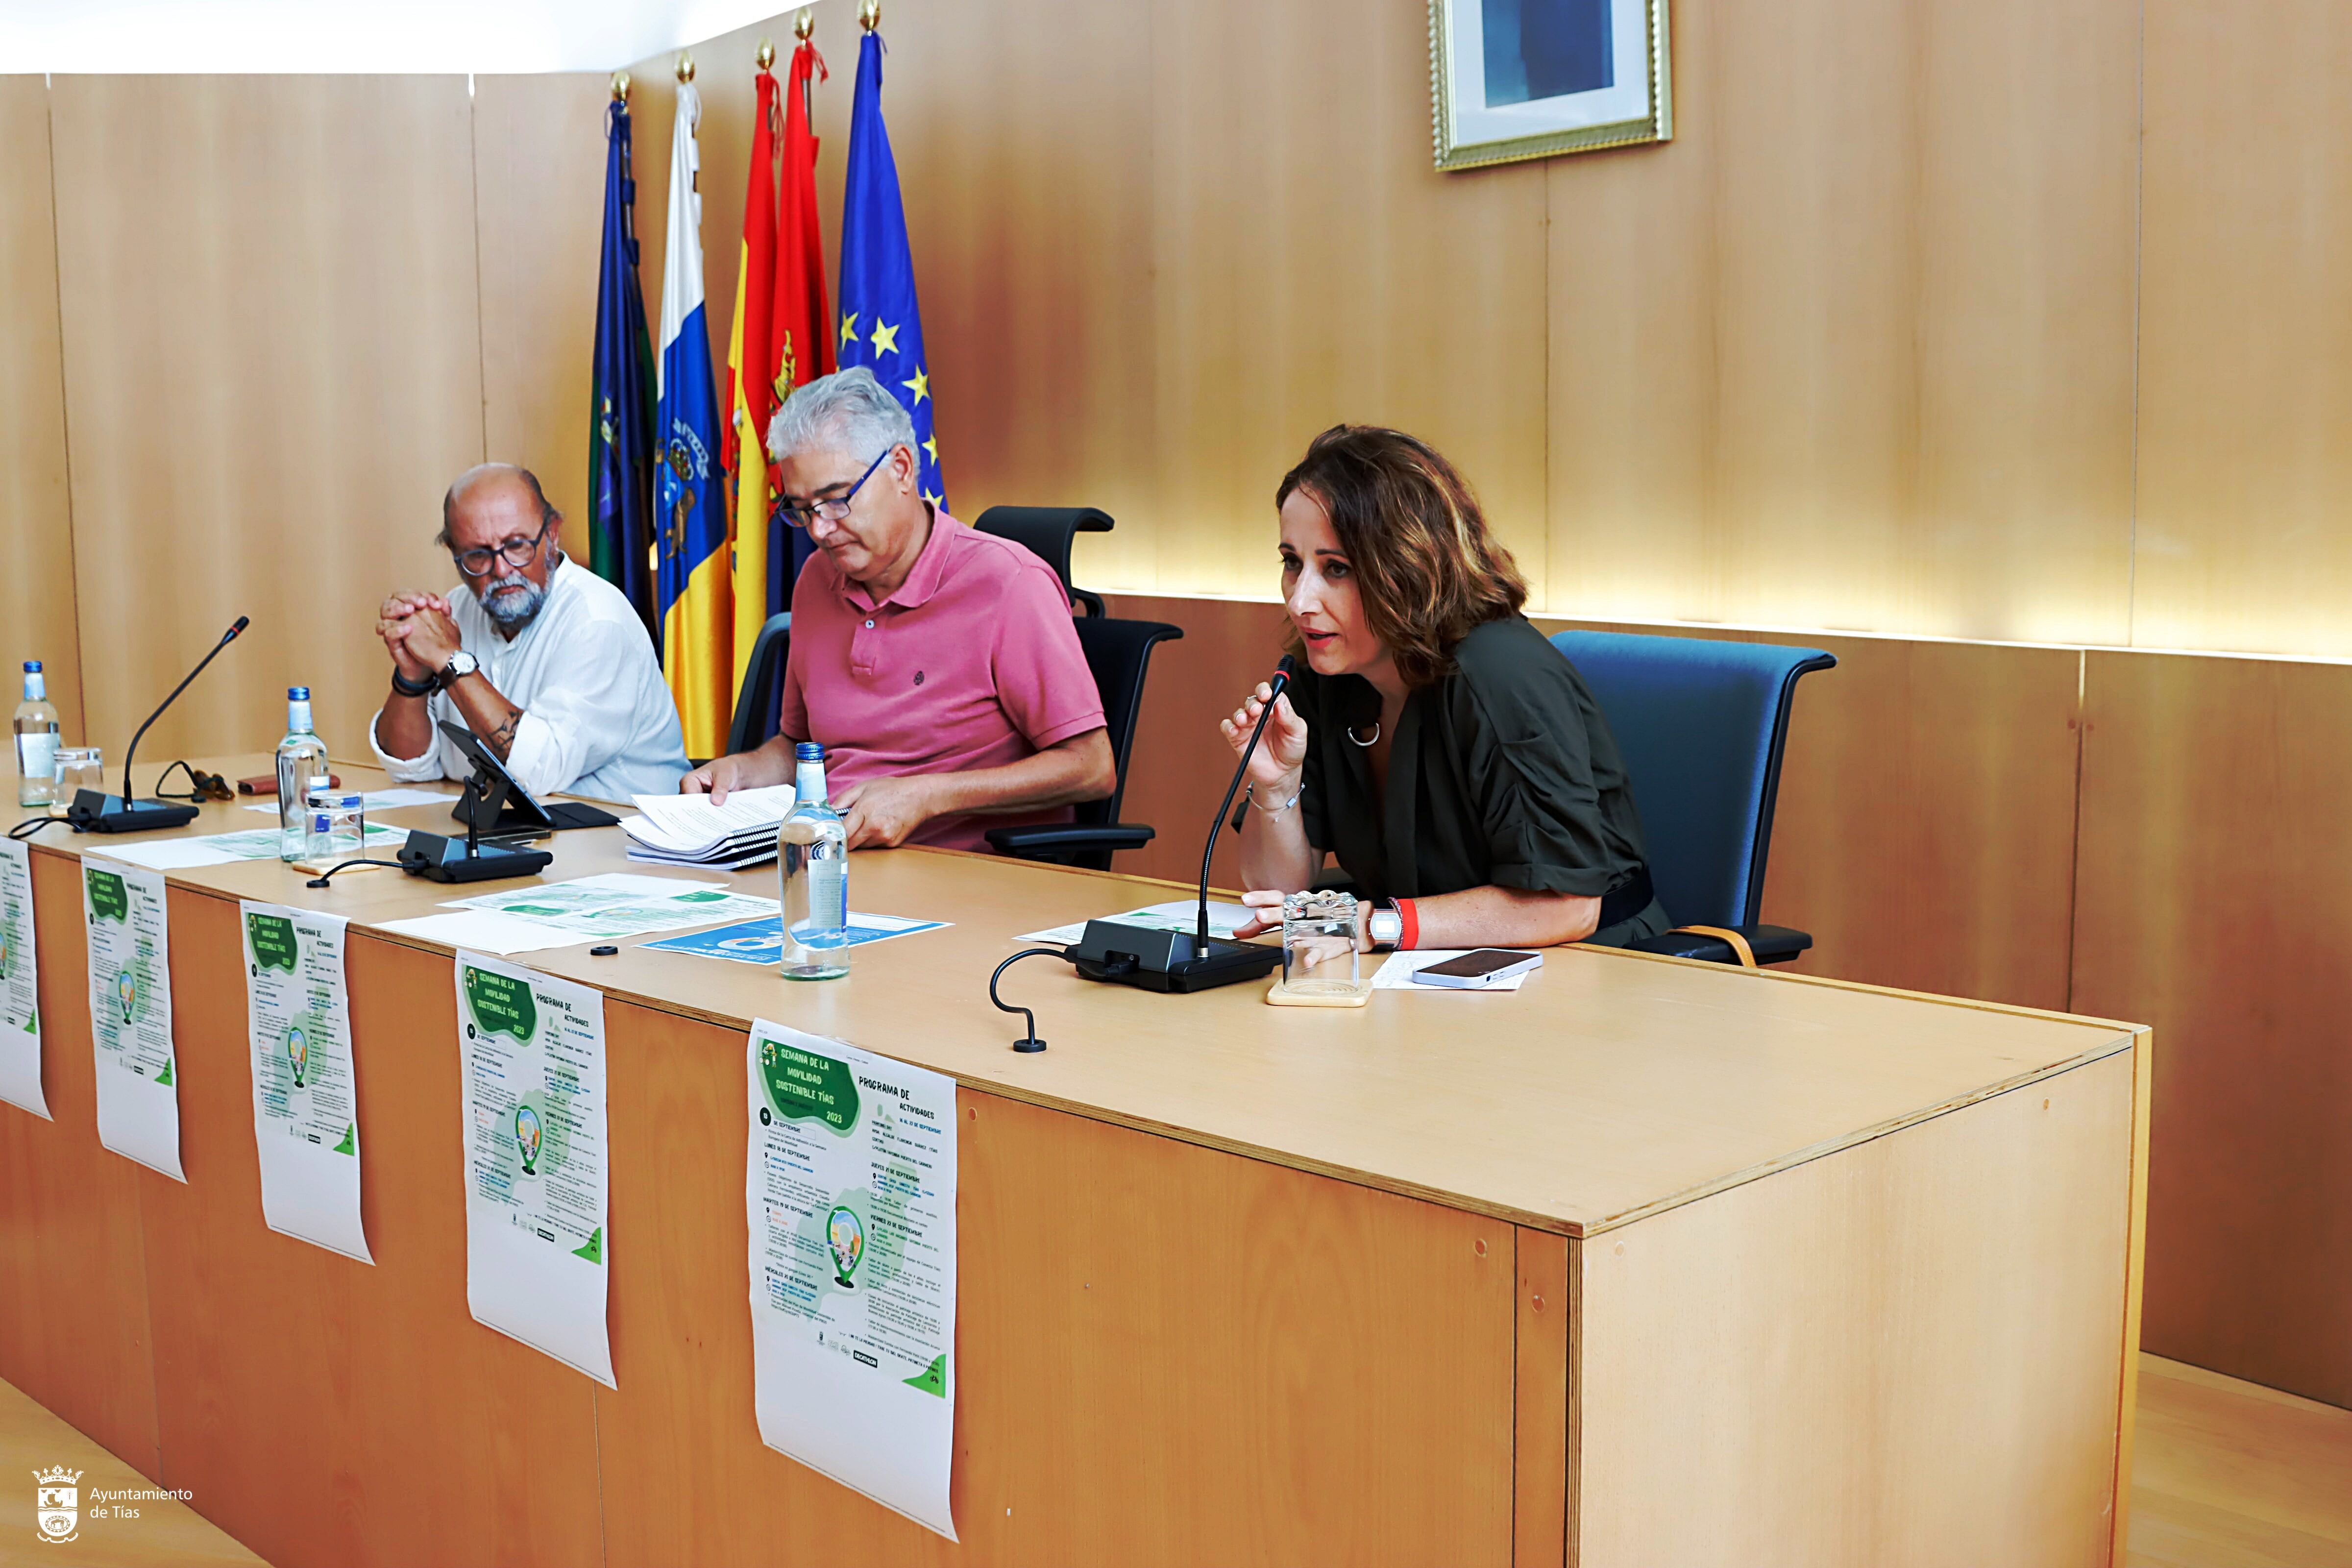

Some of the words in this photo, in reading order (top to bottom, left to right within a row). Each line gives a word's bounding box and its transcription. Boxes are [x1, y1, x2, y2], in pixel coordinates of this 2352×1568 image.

[501, 979, 507, 988] DE
[508, 980, 514, 990] LA
[537, 993, 563, 1009] PROGRAMA
[565, 1002, 571, 1011] DE
[564, 1014, 588, 1027] ACTIVIDADES
[781, 1049, 808, 1065] SEMANA
[810, 1057, 817, 1068] DE
[820, 1060, 829, 1071] LA
[787, 1066, 822, 1085] MOVILIDAD
[776, 1078, 815, 1100] SOSTENIBLE
[818, 1089, 833, 1105] TÍAS
[859, 1076, 898, 1097] PROGRAMA
[901, 1088, 909, 1100] DE
[827, 1110, 842, 1124] 2023
[900, 1102, 934, 1120] ACTIVIDADES
[779, 1122, 800, 1133] SEPTIEMBRE
[919, 1123, 941, 1135] SEPTIEMBRE
[764, 1141, 775, 1150] LUNES
[787, 1149, 809, 1161] SEPTIEMBRE
[871, 1162, 884, 1171] JUEVES
[896, 1170, 920, 1183] SEPTIEMBRE
[763, 1196, 778, 1206] MARTES
[790, 1205, 812, 1218] SEPTIEMBRE
[871, 1214, 885, 1224] VIERNES
[898, 1224, 922, 1237] SEPTIEMBRE
[795, 1276, 817, 1291] SEPTIEMBRE
